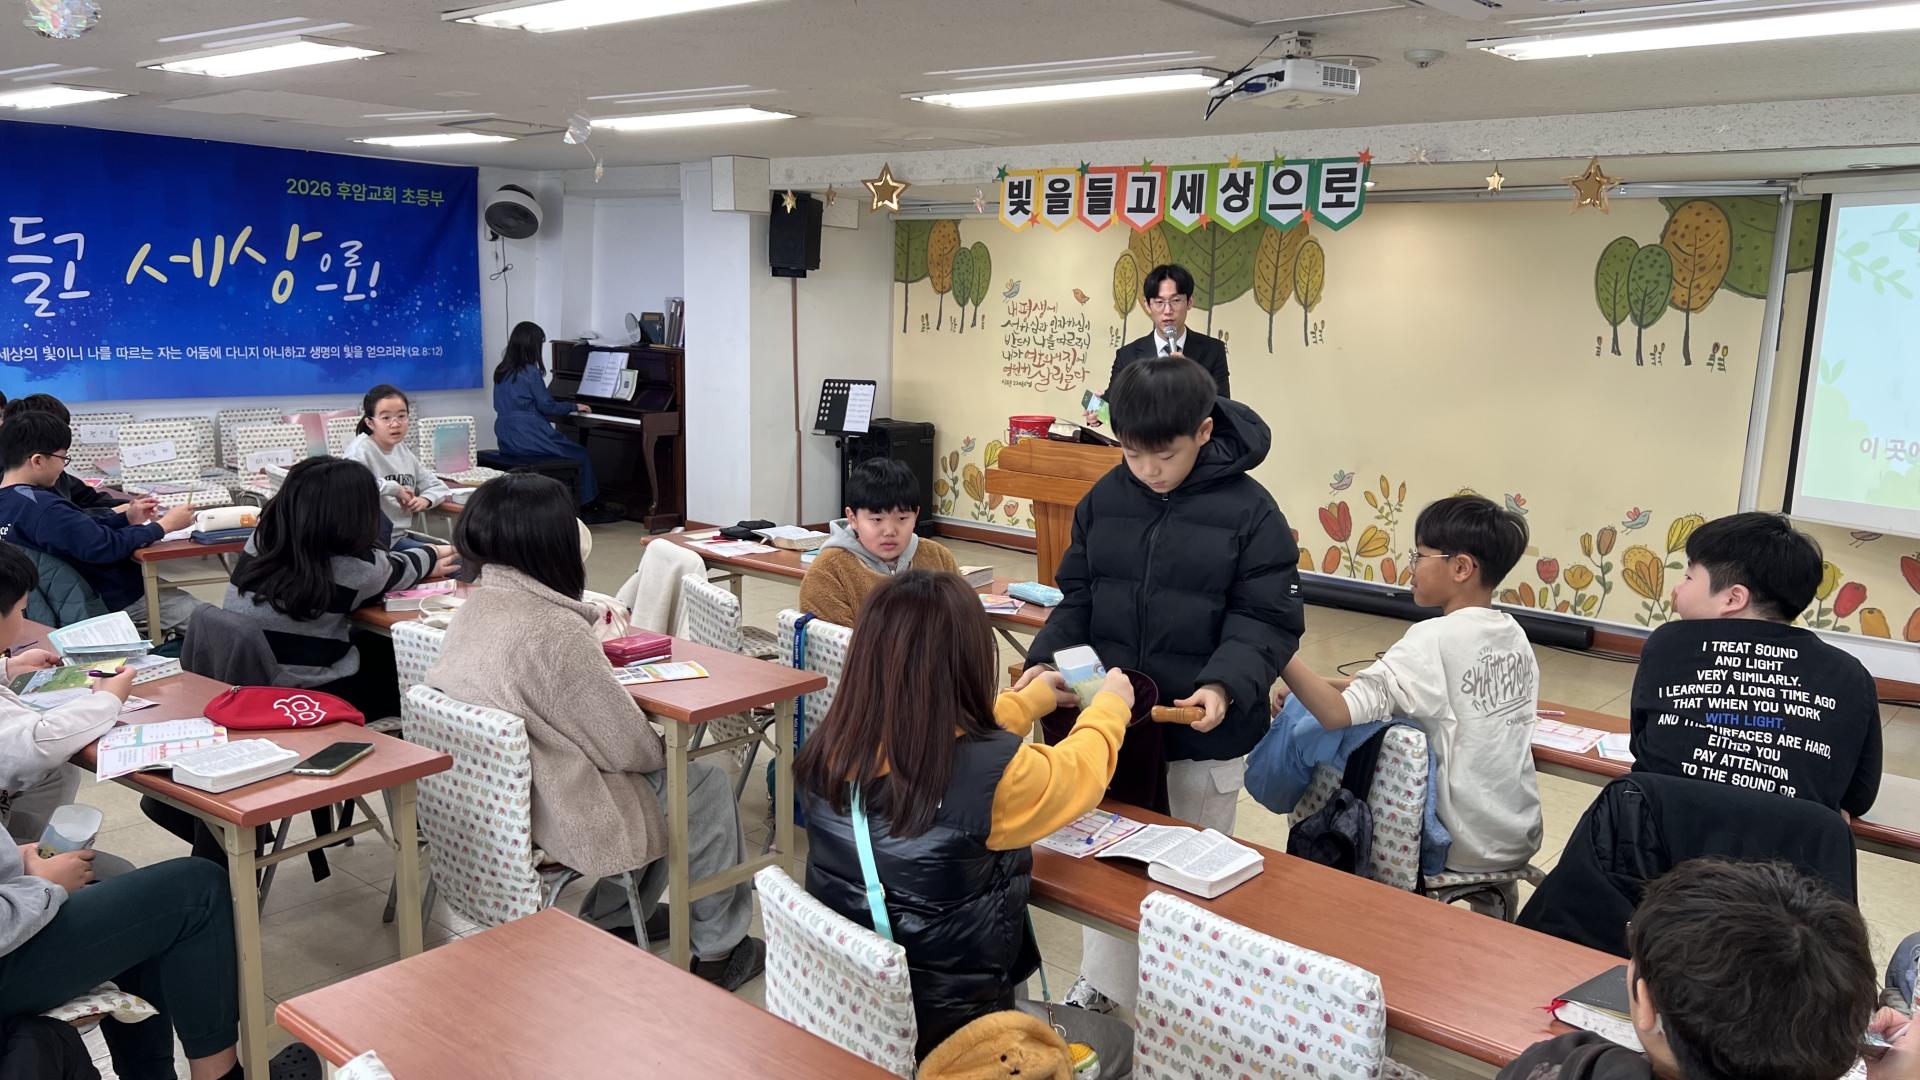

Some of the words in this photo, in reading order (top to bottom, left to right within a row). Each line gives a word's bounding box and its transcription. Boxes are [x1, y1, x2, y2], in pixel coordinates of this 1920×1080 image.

[286, 178, 332, 197] 2026
[336, 181, 397, 204] 후암교회
[401, 188, 445, 207] 초등부
[8, 216, 91, 317] 들고
[42, 345, 83, 361] 빛이니
[87, 346, 113, 361] 나를
[116, 346, 154, 360] 따르는
[157, 346, 182, 360] 자는
[186, 346, 222, 360] 어둠에
[225, 346, 260, 359] 다니지
[262, 346, 307, 359] 아니하고
[309, 346, 340, 359] 생명의
[343, 344, 363, 359] 빛을
[366, 345, 406, 358] 얻으리라
[1860, 437, 1879, 460] 이
[1702, 641, 1707, 652] I
[1712, 641, 1752, 654] TREAT
[1754, 643, 1799, 659] SOUND
[1714, 655, 1741, 668] AND
[1745, 657, 1784, 672] LIGHT
[1696, 669, 1729, 681] VERY
[1732, 671, 1802, 687] SIMILARLY.
[1658, 687, 1663, 698] I
[1666, 683, 1722, 697] LEARNED
[1725, 684, 1735, 695] A
[1740, 684, 1776, 698] LONG
[1780, 688, 1810, 703] TIME
[1814, 694, 1837, 710] AGO
[1673, 697, 1703, 709] THAT
[1707, 697, 1748, 711] WHEN
[1753, 700, 1779, 713] YOU
[1784, 703, 1821, 722] WORK
[1705, 712, 1739, 725] WITH
[1744, 714, 1787, 731] LIGHT,
[1657, 713, 1679, 726] AND
[1776, 734, 1802, 750] ARE
[1805, 739, 1832, 759] HARD,
[1707, 733, 1751, 754] EITHER
[1755, 746, 1781, 761] YOU
[1693, 747, 1718, 764] PAY
[1720, 753, 1789, 781] ATTENTION
[1681, 761, 1698, 776] TO
[1702, 766, 1728, 783] THE
[1731, 773, 1776, 793] SOUND
[1779, 785, 1796, 798] OR
